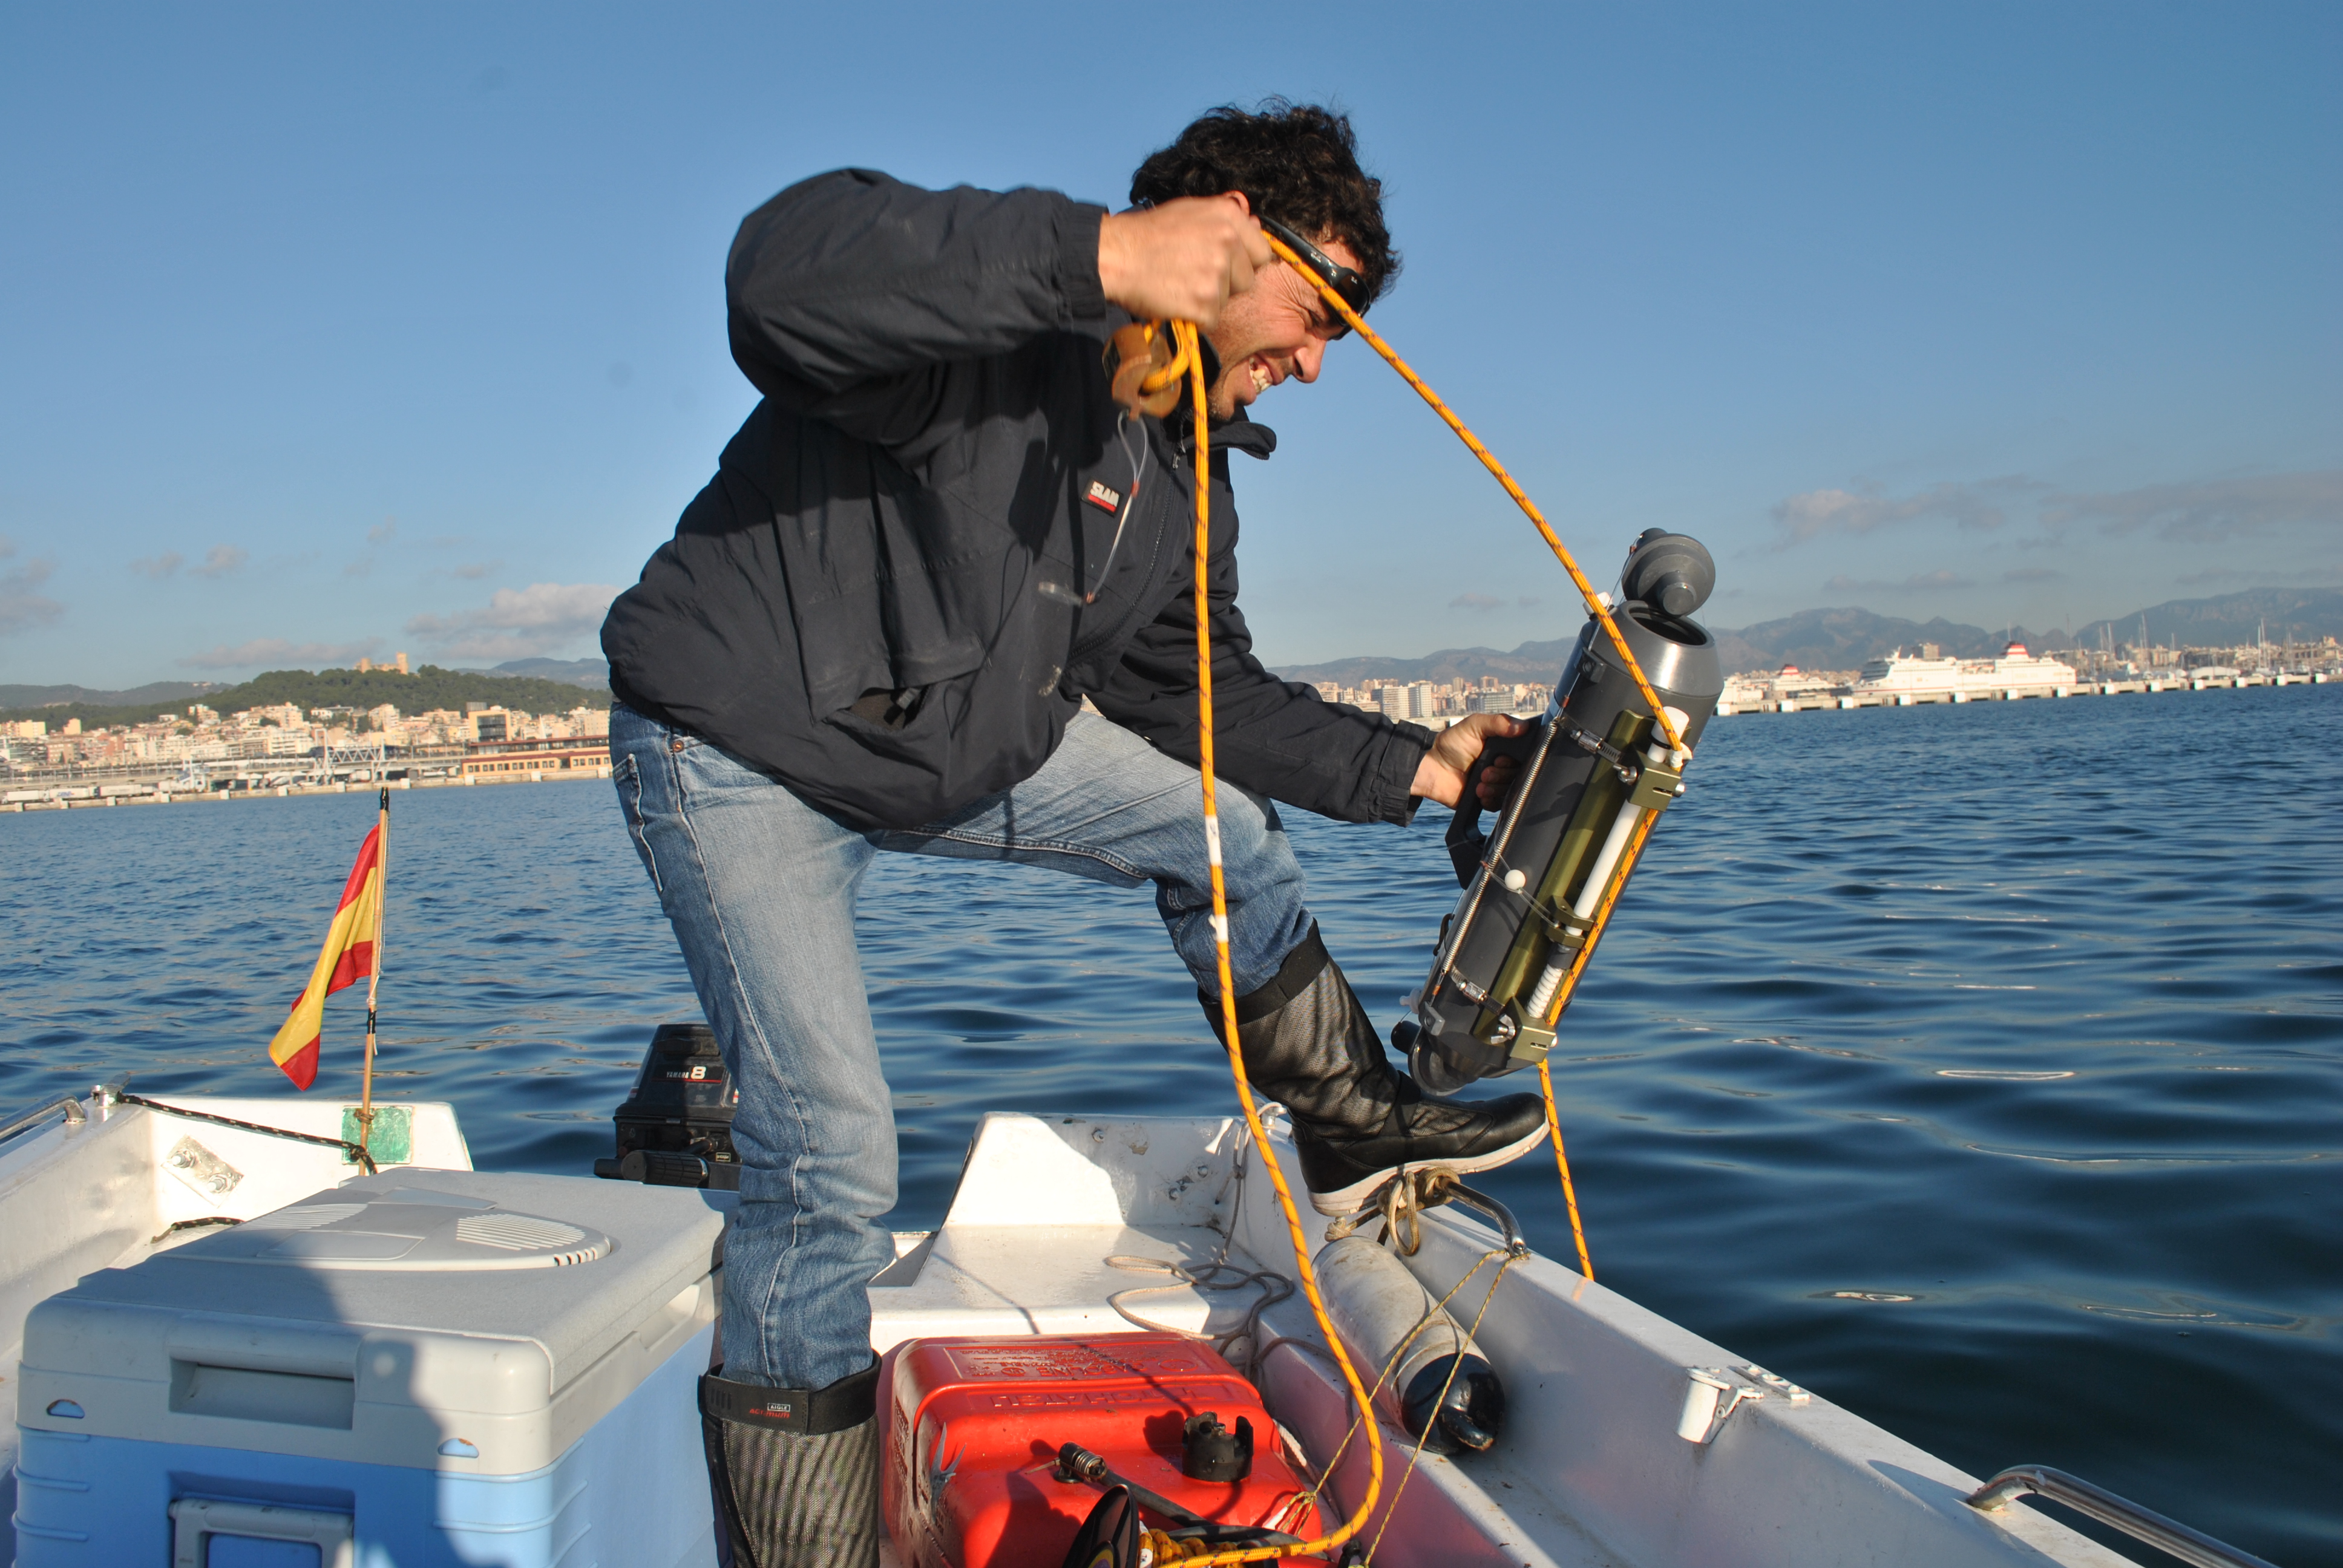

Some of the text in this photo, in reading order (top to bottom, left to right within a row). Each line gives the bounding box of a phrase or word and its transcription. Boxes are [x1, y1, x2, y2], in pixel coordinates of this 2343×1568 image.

[1090, 481, 1119, 508] SLAM
[690, 1066, 707, 1080] 8
[990, 1390, 1165, 1408] TOHATSU
